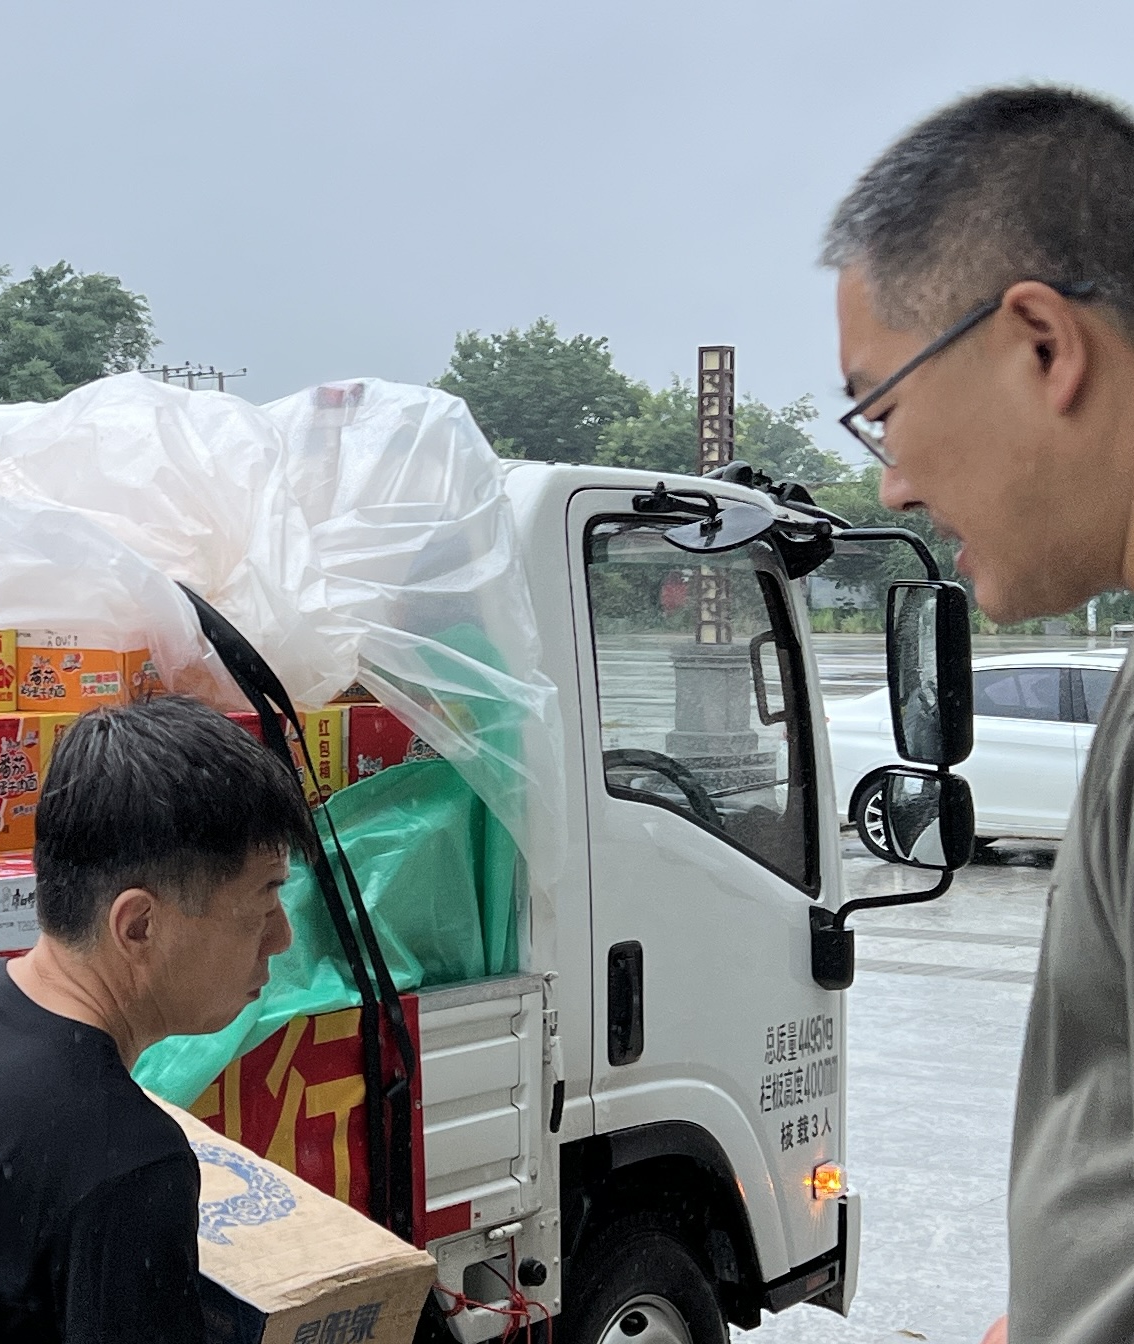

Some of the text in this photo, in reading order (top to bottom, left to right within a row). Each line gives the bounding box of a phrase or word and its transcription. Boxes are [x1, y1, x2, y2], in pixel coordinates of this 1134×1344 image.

[318, 718, 331, 780] 红包箱
[780, 1106, 832, 1152] 核载3人
